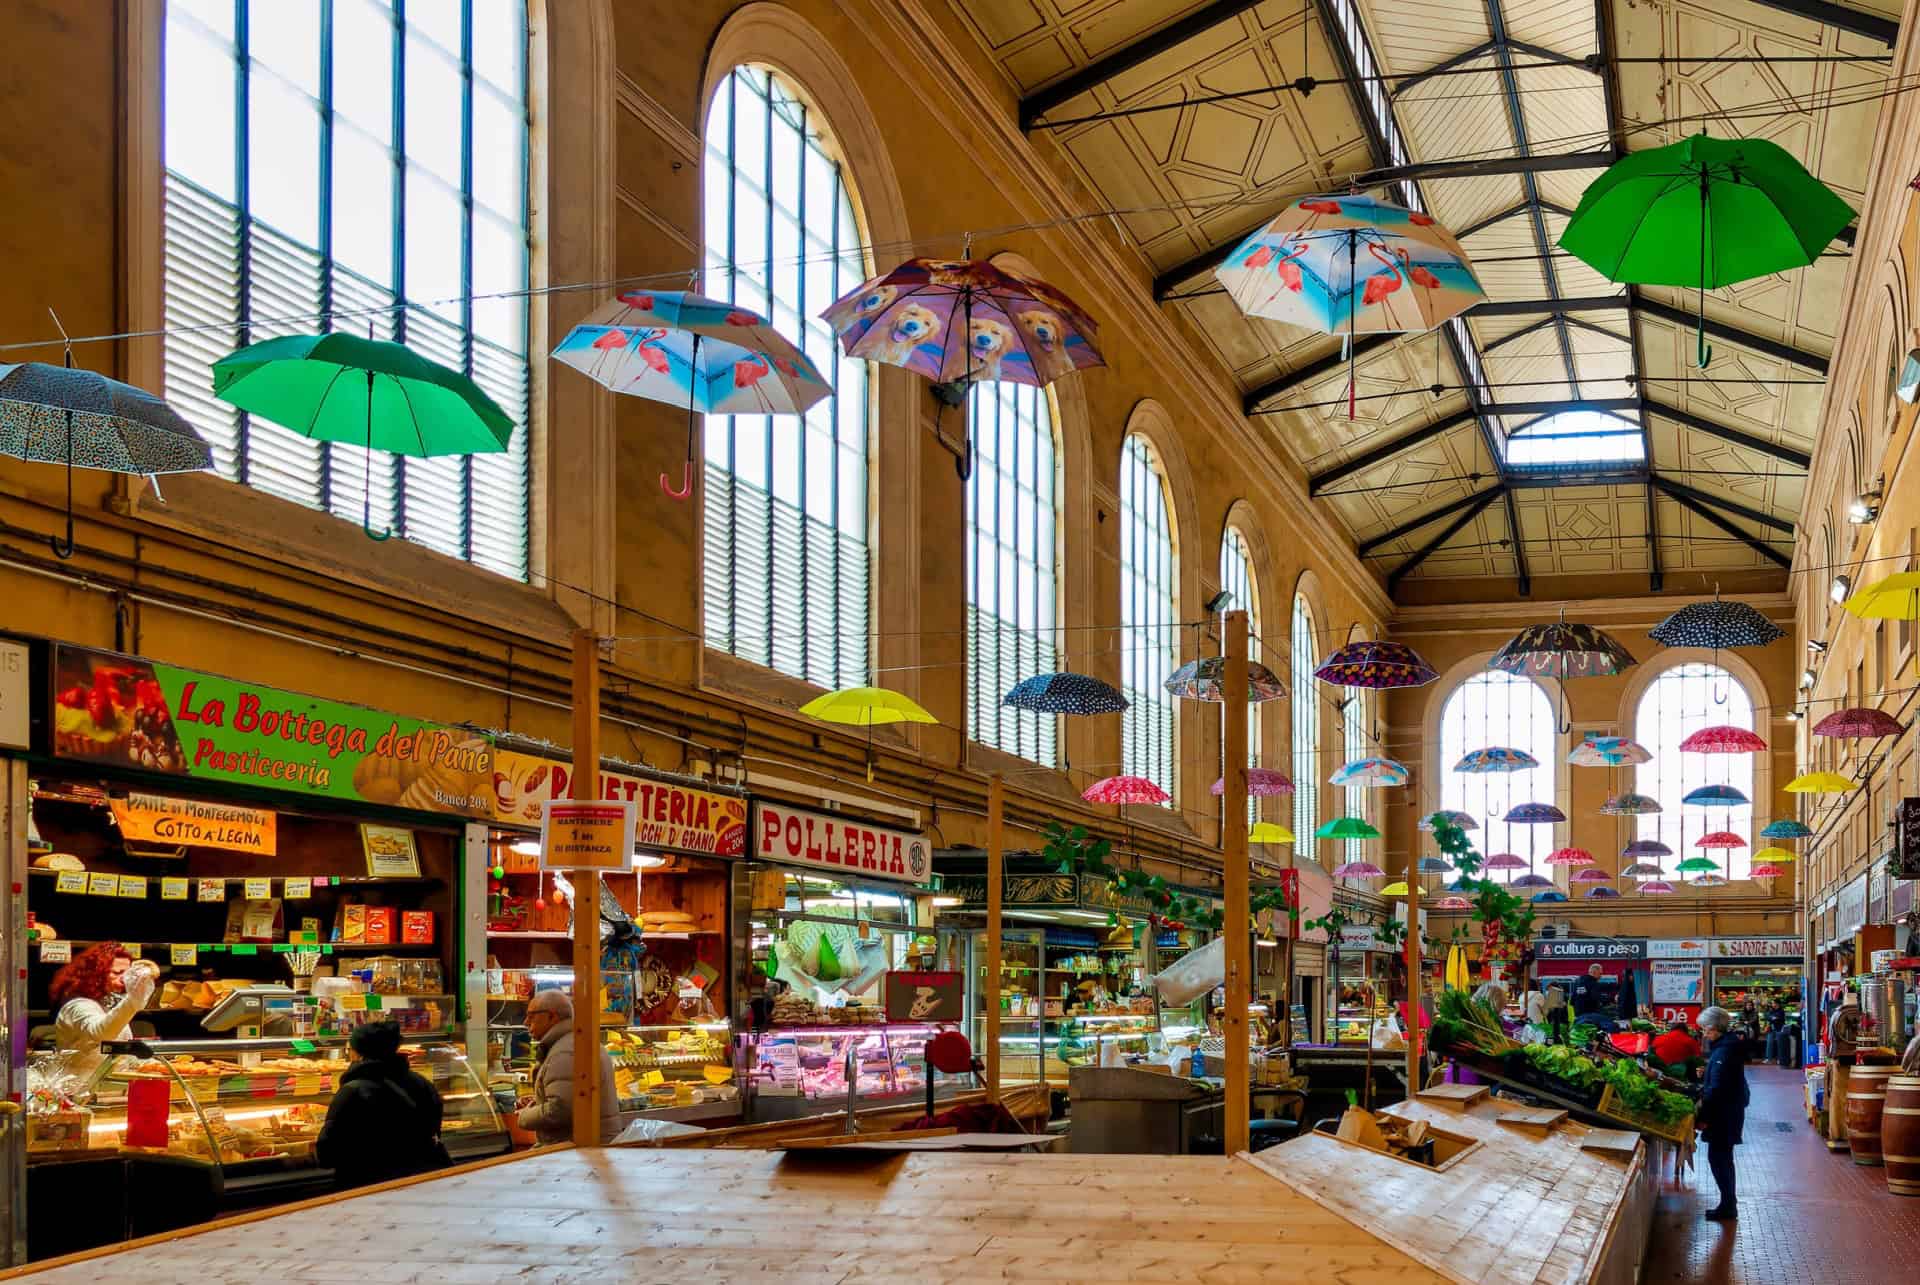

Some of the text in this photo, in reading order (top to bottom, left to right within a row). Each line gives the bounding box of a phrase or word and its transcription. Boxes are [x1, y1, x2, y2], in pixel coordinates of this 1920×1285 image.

[177, 681, 489, 774] La Bottega del Pane
[194, 737, 330, 786] Pasticceria
[127, 796, 168, 811] PANE
[435, 789, 467, 807] Banco
[153, 817, 200, 839] COTTO
[217, 826, 261, 846] LEGNA
[571, 829, 578, 841] 1
[682, 829, 715, 851] GRANO
[762, 809, 905, 874] POLLERIA
[1554, 943, 1639, 956] cultura a peso
[1730, 940, 1768, 956] SAPORE
[1663, 1007, 1688, 1023] Dé
